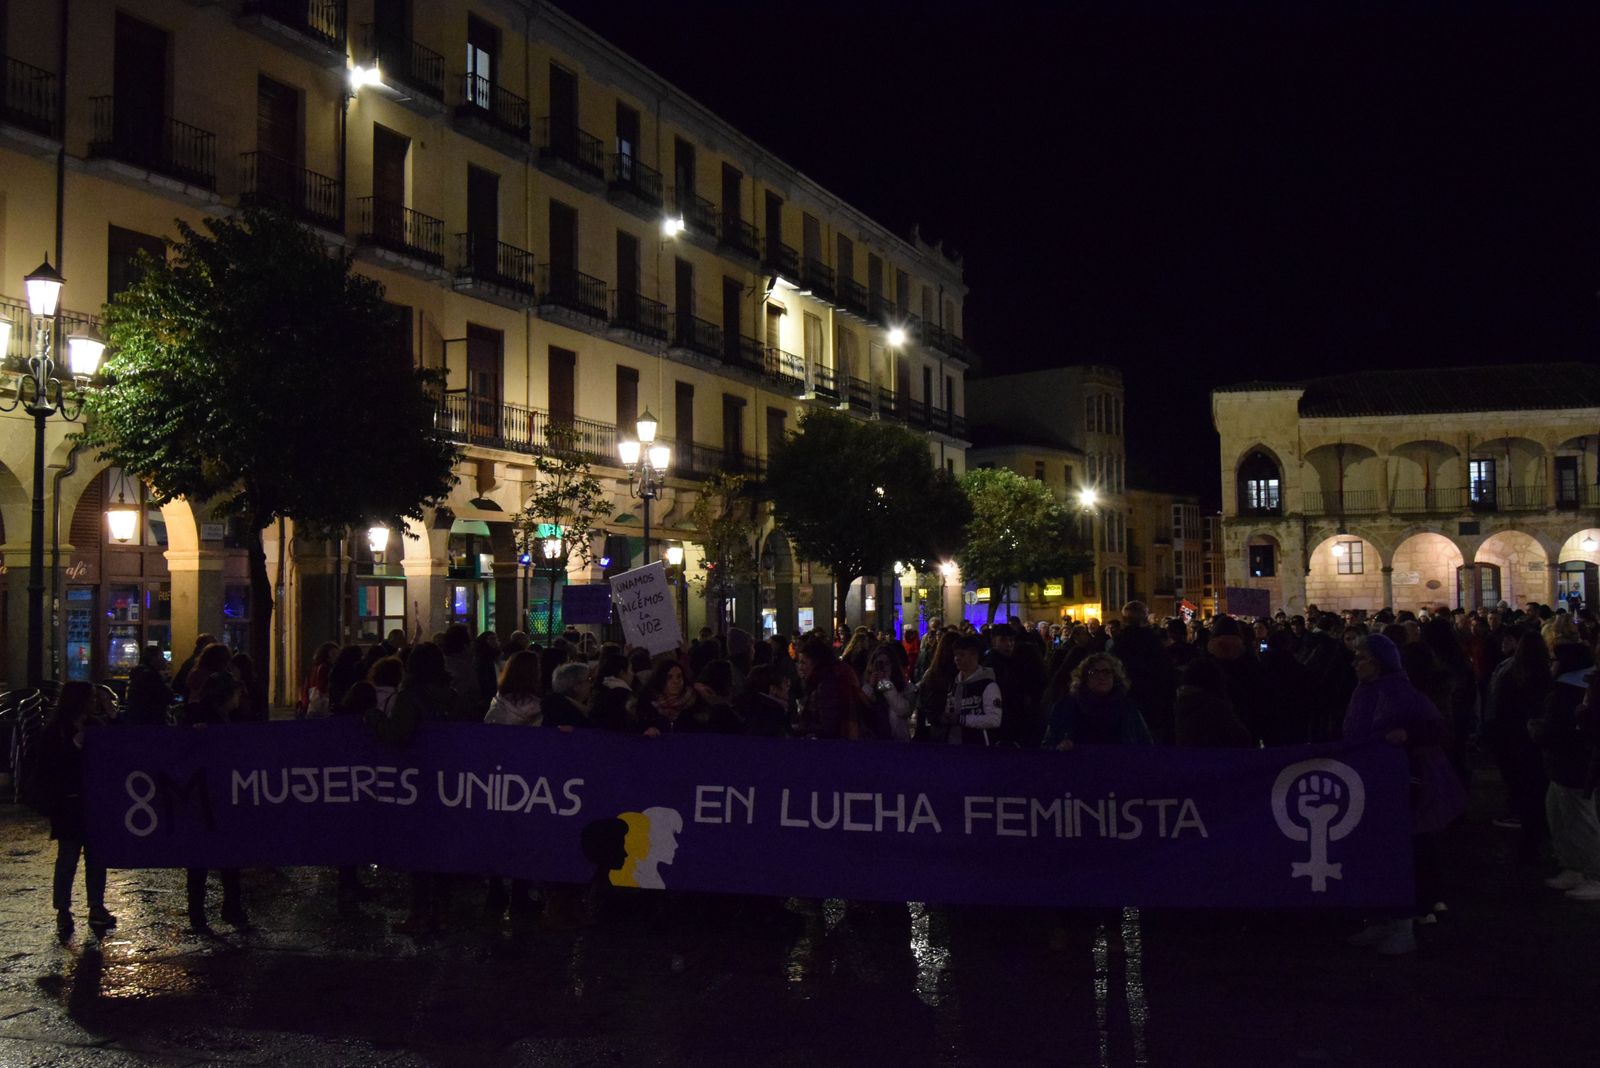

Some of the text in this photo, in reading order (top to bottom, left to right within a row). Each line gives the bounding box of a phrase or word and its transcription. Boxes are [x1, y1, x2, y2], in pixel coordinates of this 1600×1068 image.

[616, 573, 654, 593] UNAMOS
[636, 618, 664, 636] VOZ
[231, 765, 420, 806] MUJERES
[694, 785, 755, 824] EN
[780, 788, 942, 833] LUCHA
